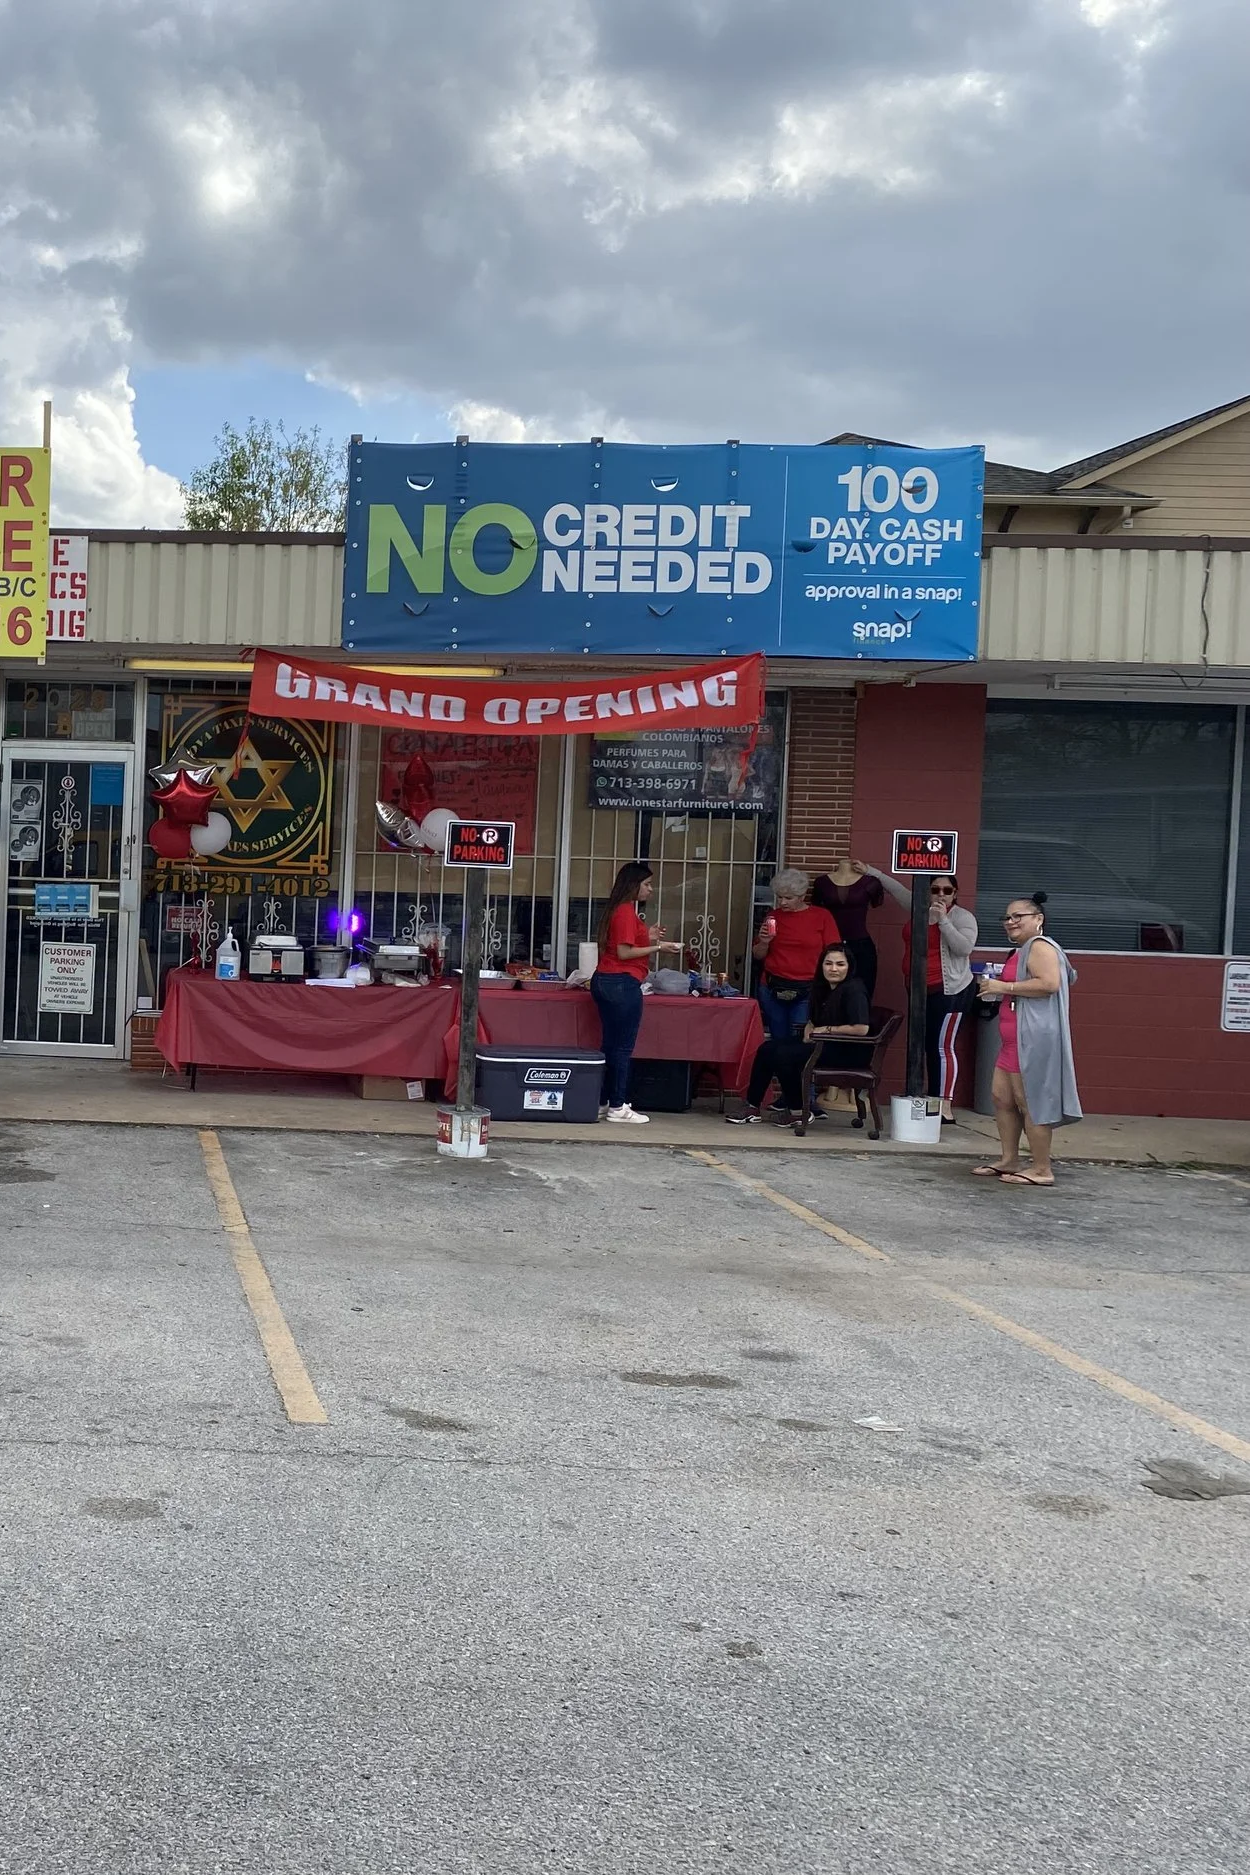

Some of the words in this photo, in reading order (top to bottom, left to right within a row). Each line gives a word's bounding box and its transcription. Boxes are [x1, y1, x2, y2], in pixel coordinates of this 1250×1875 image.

[837, 465, 939, 515] 100
[810, 518, 868, 541] DAY
[880, 517, 964, 542] CASH
[53, 539, 70, 566] E
[365, 502, 537, 595] NO
[542, 502, 751, 549] CREDIT
[828, 542, 942, 566] PAYOFF
[542, 550, 773, 594] NEEDED
[50, 572, 86, 599] CS
[804, 583, 880, 602] approval
[884, 584, 898, 599] in
[901, 587, 912, 600] a
[915, 586, 963, 604] snap!
[852, 620, 912, 643] snap!
[275, 662, 466, 722] GRAND
[483, 670, 738, 726] OPENING
[258, 716, 315, 773] SERVICES
[642, 732, 724, 743] COLOMBIANOS
[606, 748, 659, 757] PERFUMES
[661, 749, 687, 758] PARA
[593, 760, 629, 769] DAMAS
[631, 760, 638, 769] Y
[640, 761, 703, 770] CABALLEROS
[609, 777, 696, 790] 713-398-6971
[598, 797, 764, 810] www.lonestarfurniture1.com
[251, 804, 313, 853] SERVICES
[460, 828, 477, 842] NO
[453, 844, 504, 862] PARKING
[907, 836, 922, 851] NO
[900, 853, 948, 868] PARKING
[155, 874, 330, 897] 713-291-4012
[44, 948, 92, 957] CUSTOMER
[50, 957, 85, 966] PARKING
[57, 966, 77, 974] ONLY
[530, 1070, 559, 1079] Coleman
